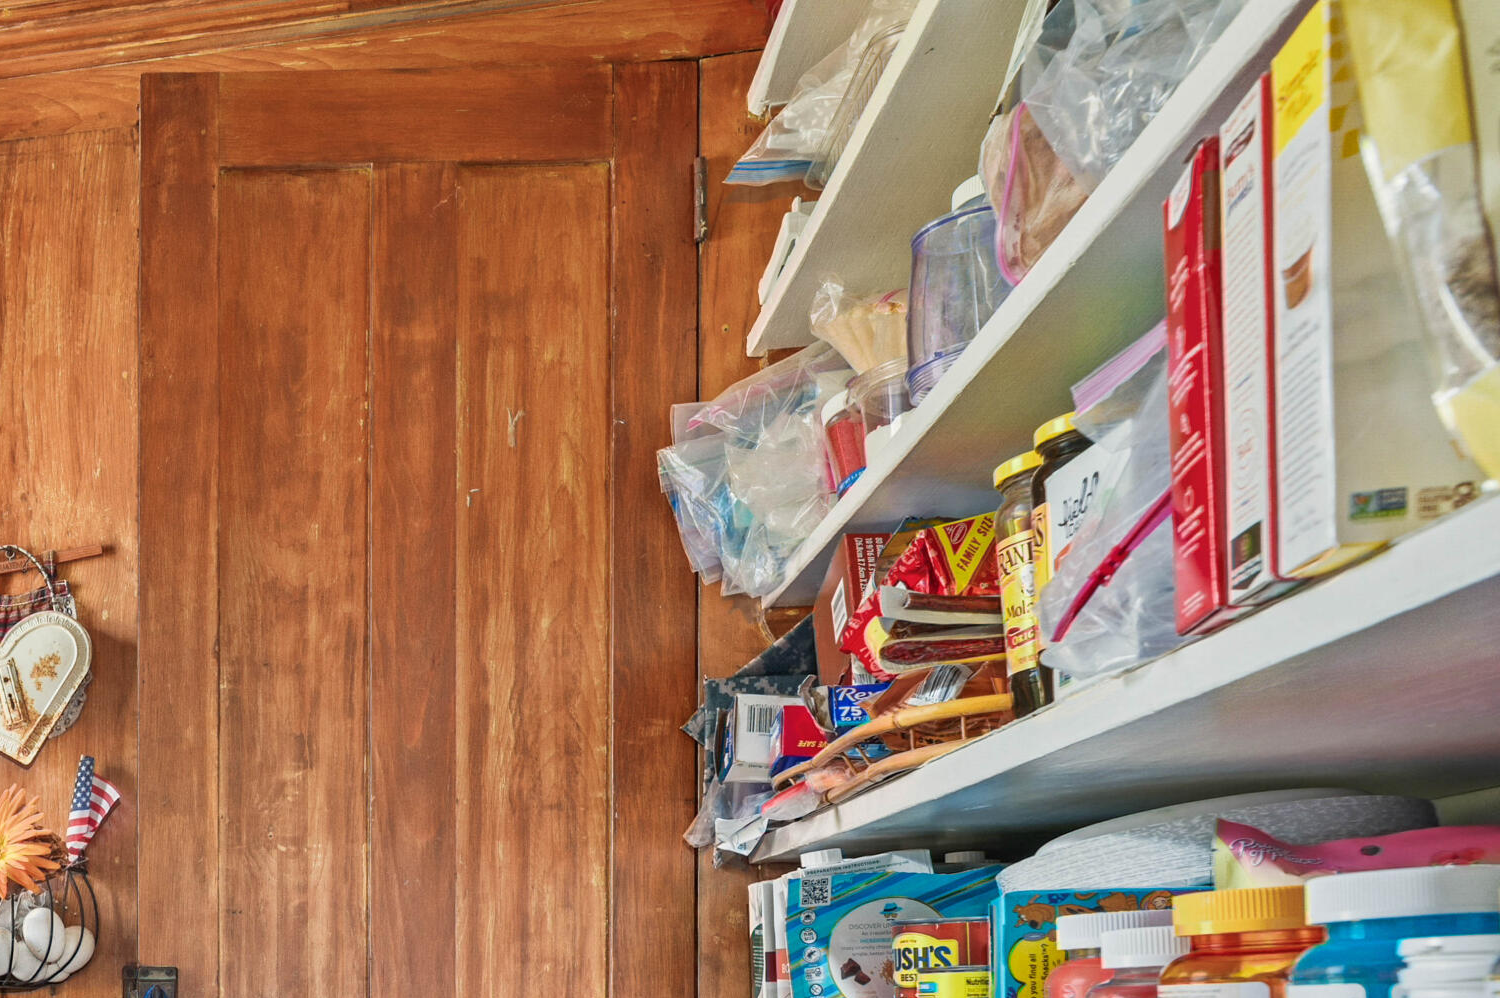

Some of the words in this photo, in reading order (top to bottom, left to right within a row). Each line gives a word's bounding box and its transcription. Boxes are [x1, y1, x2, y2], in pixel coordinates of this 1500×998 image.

[956, 537, 982, 572] FAMILY
[838, 706, 862, 717] 75
[1028, 953, 1037, 962] all
[1028, 964, 1037, 979] find
[1030, 981, 1038, 995] you
